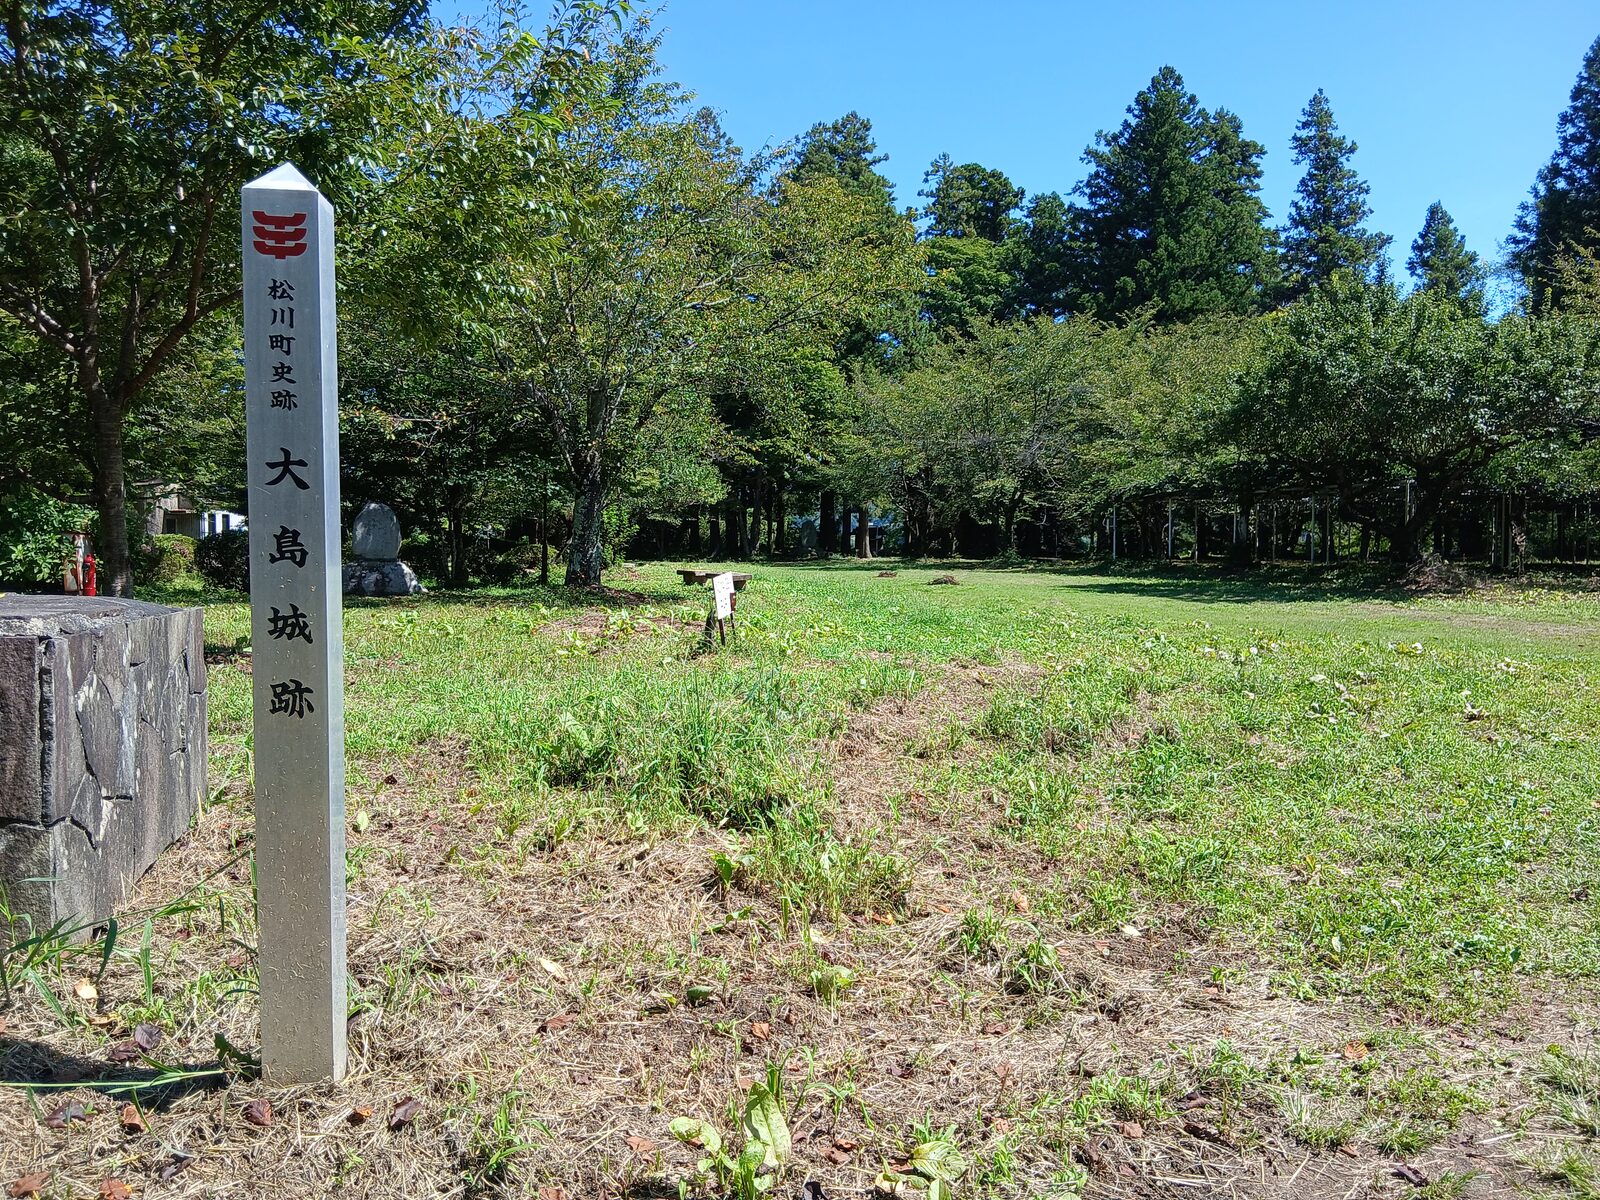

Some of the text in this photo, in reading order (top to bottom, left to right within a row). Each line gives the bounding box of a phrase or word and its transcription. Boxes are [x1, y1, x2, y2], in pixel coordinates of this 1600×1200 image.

[265, 277, 315, 720] 松川町史跡 大島城跡
